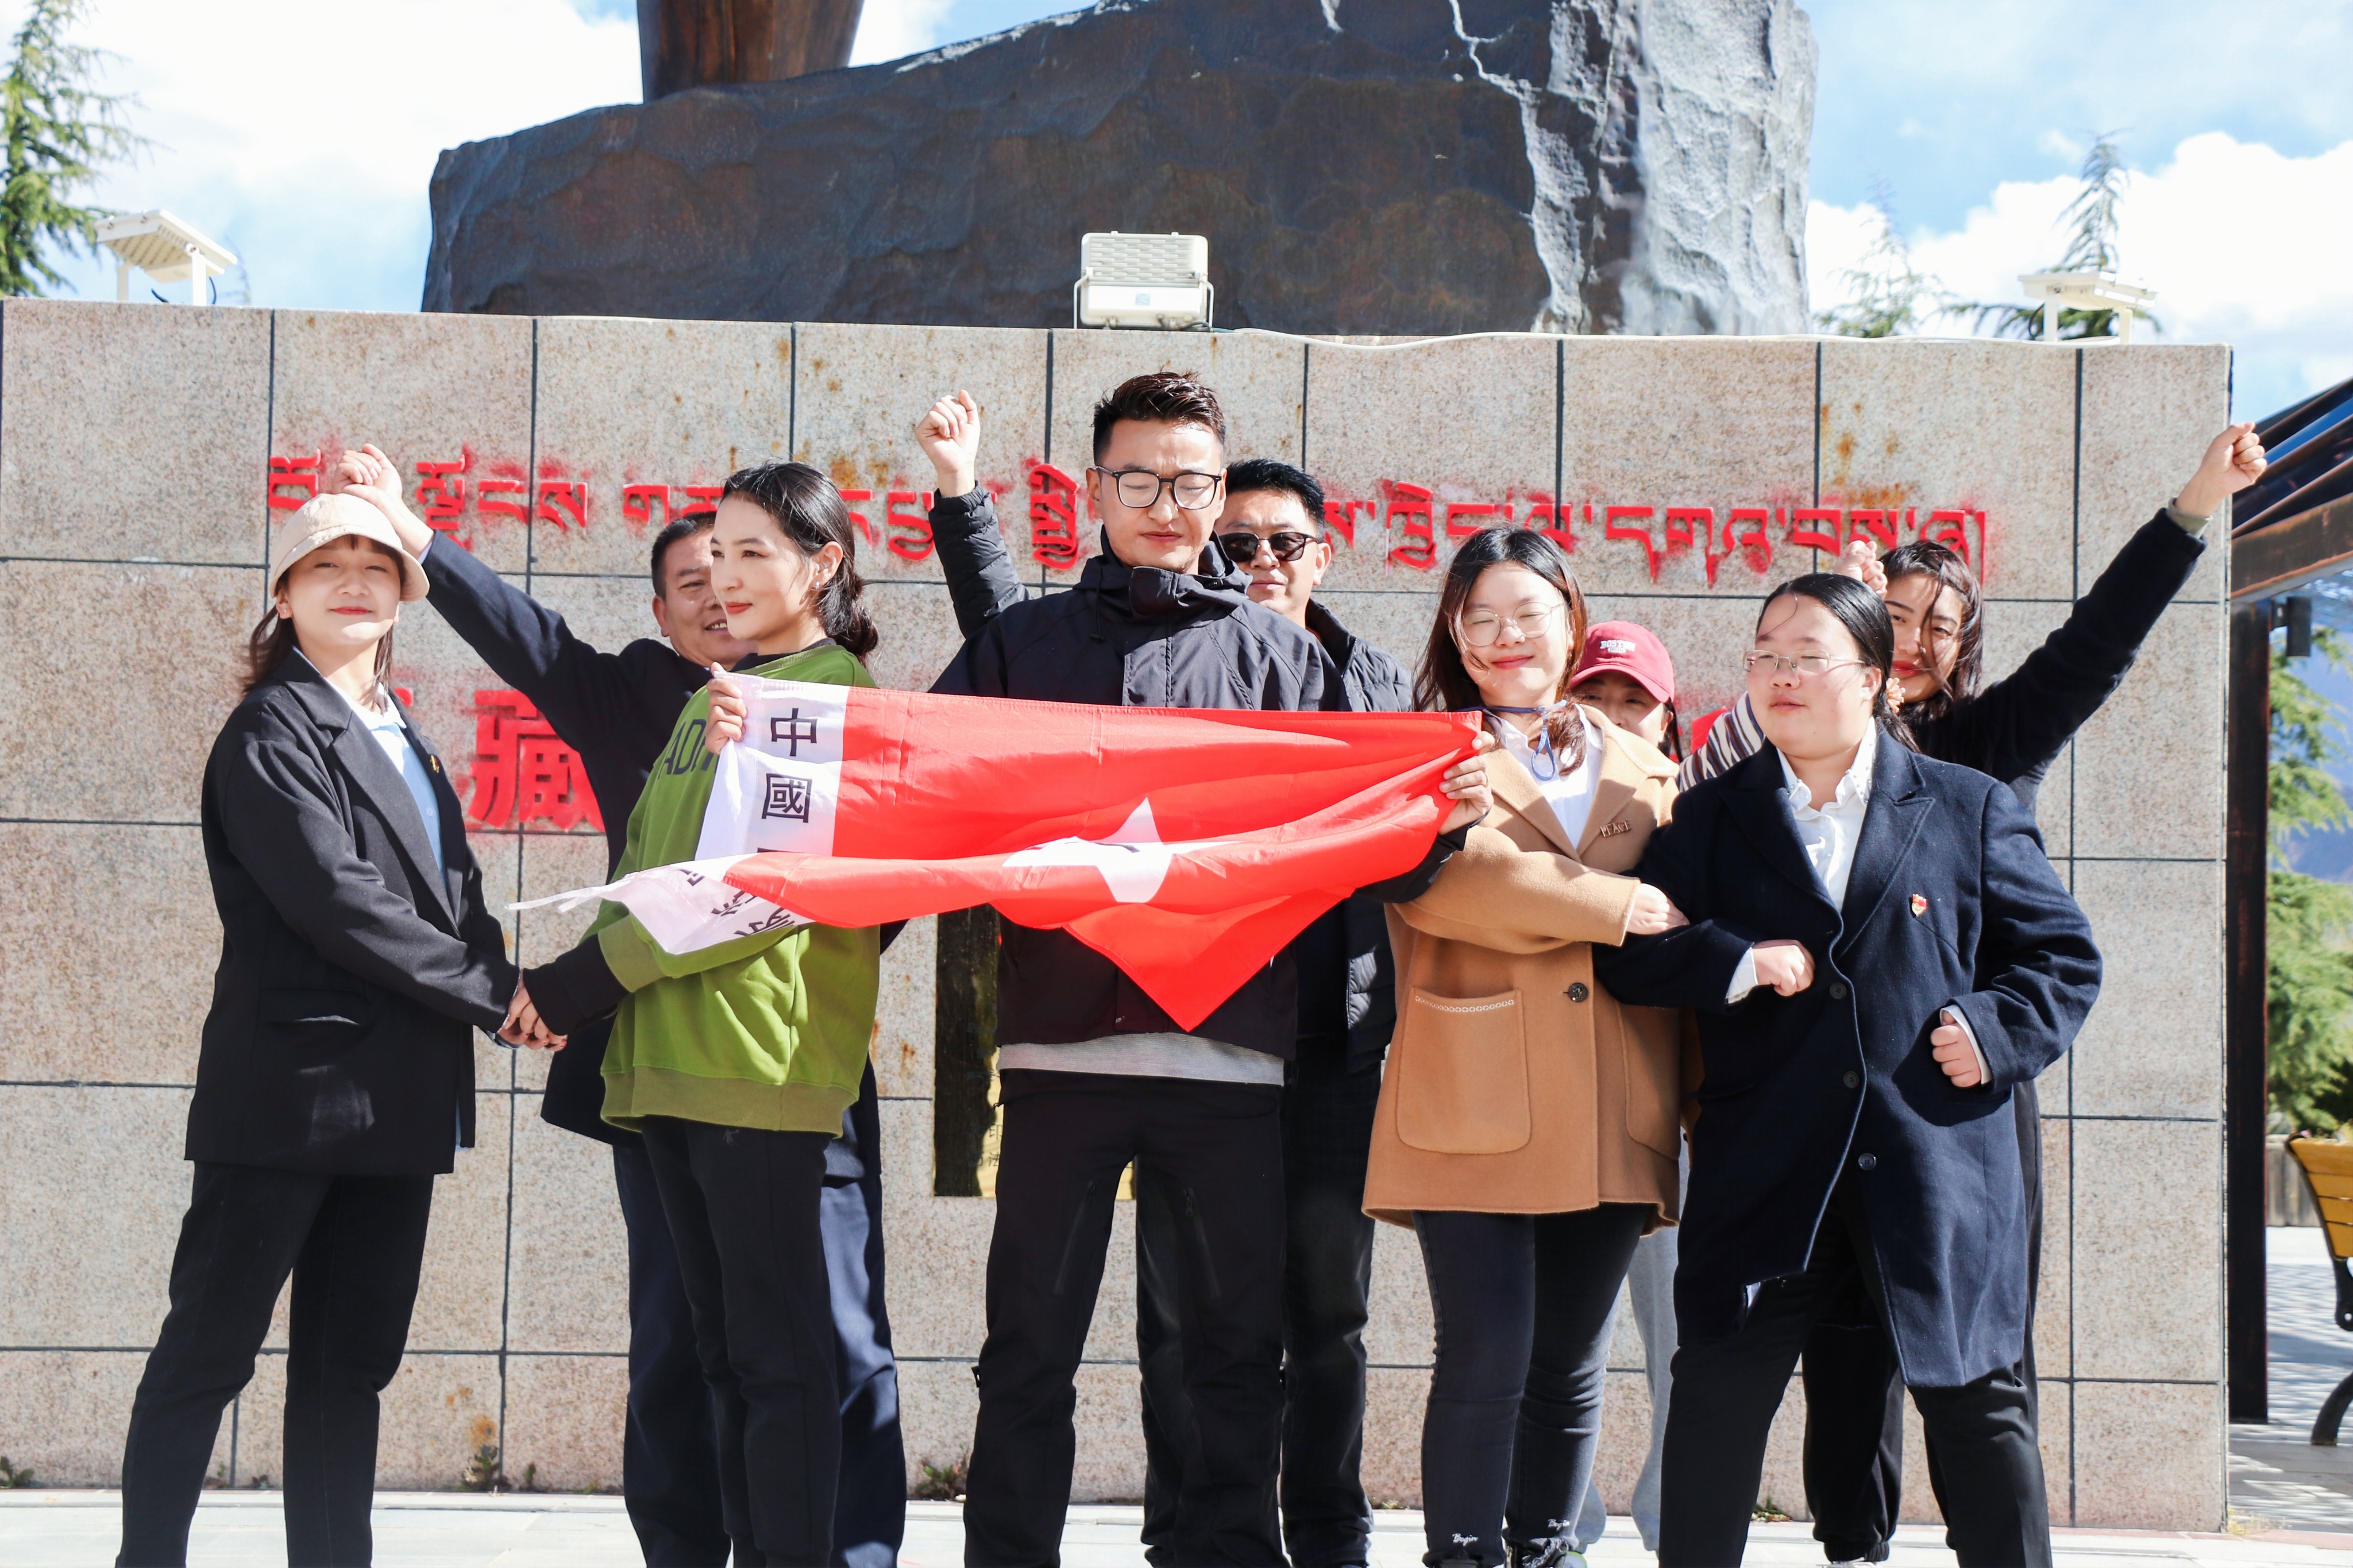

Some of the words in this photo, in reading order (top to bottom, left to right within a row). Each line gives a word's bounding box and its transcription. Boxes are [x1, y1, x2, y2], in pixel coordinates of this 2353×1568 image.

[1599, 639, 1636, 651] BOSTON
[757, 707, 818, 853] 中國
[1600, 819, 1631, 837] PEACE
[1452, 1533, 1478, 1546] Begin
